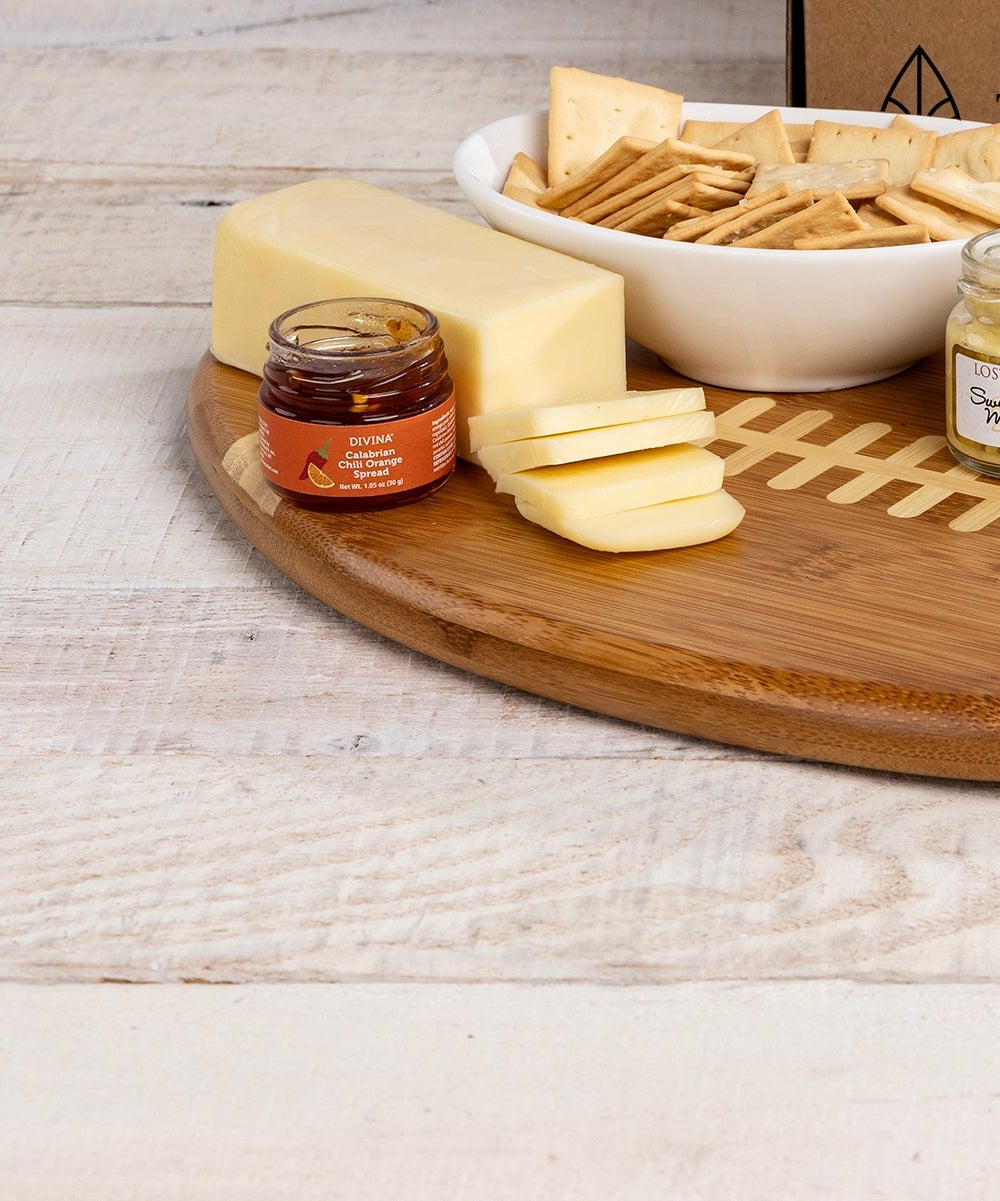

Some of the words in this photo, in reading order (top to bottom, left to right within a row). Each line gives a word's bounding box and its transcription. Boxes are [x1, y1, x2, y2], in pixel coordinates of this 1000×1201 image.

[349, 433, 393, 446] DIVINA
[345, 448, 396, 460] Calabrian
[338, 460, 363, 469] Chili
[365, 456, 403, 468] Orange
[353, 467, 389, 480] Spread
